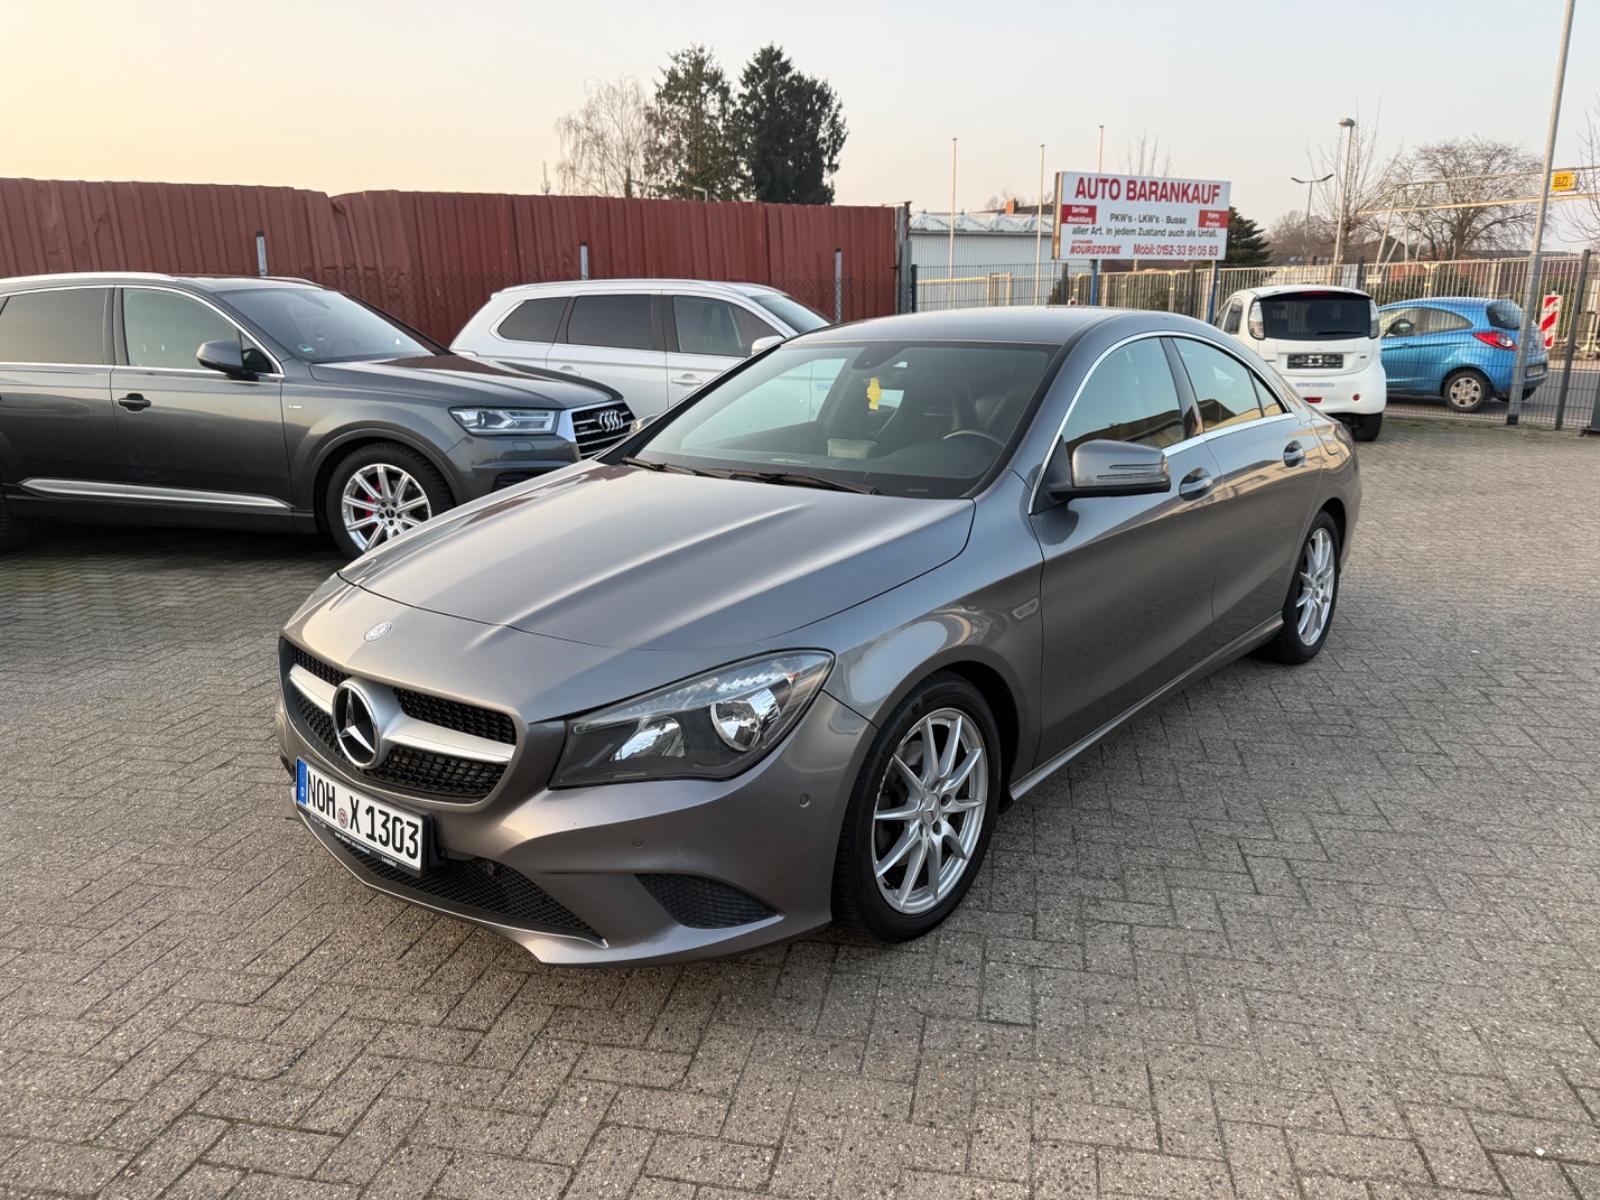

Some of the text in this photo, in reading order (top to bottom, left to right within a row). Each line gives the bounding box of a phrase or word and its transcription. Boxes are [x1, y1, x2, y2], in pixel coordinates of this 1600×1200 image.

[1075, 177, 1221, 204] AUTO BARANKAUF
[1110, 213, 1187, 225] PKW's LKW's Busse
[1072, 226, 1089, 235] aller
[1114, 228, 1136, 237] jedem
[1138, 227, 1166, 237] Zustand
[1168, 228, 1184, 238] auch
[1186, 229, 1196, 238] als
[1070, 246, 1121, 254] NOUREDDINE
[308, 771, 336, 819] NOH
[349, 796, 360, 834] X
[365, 805, 419, 860] 1303
